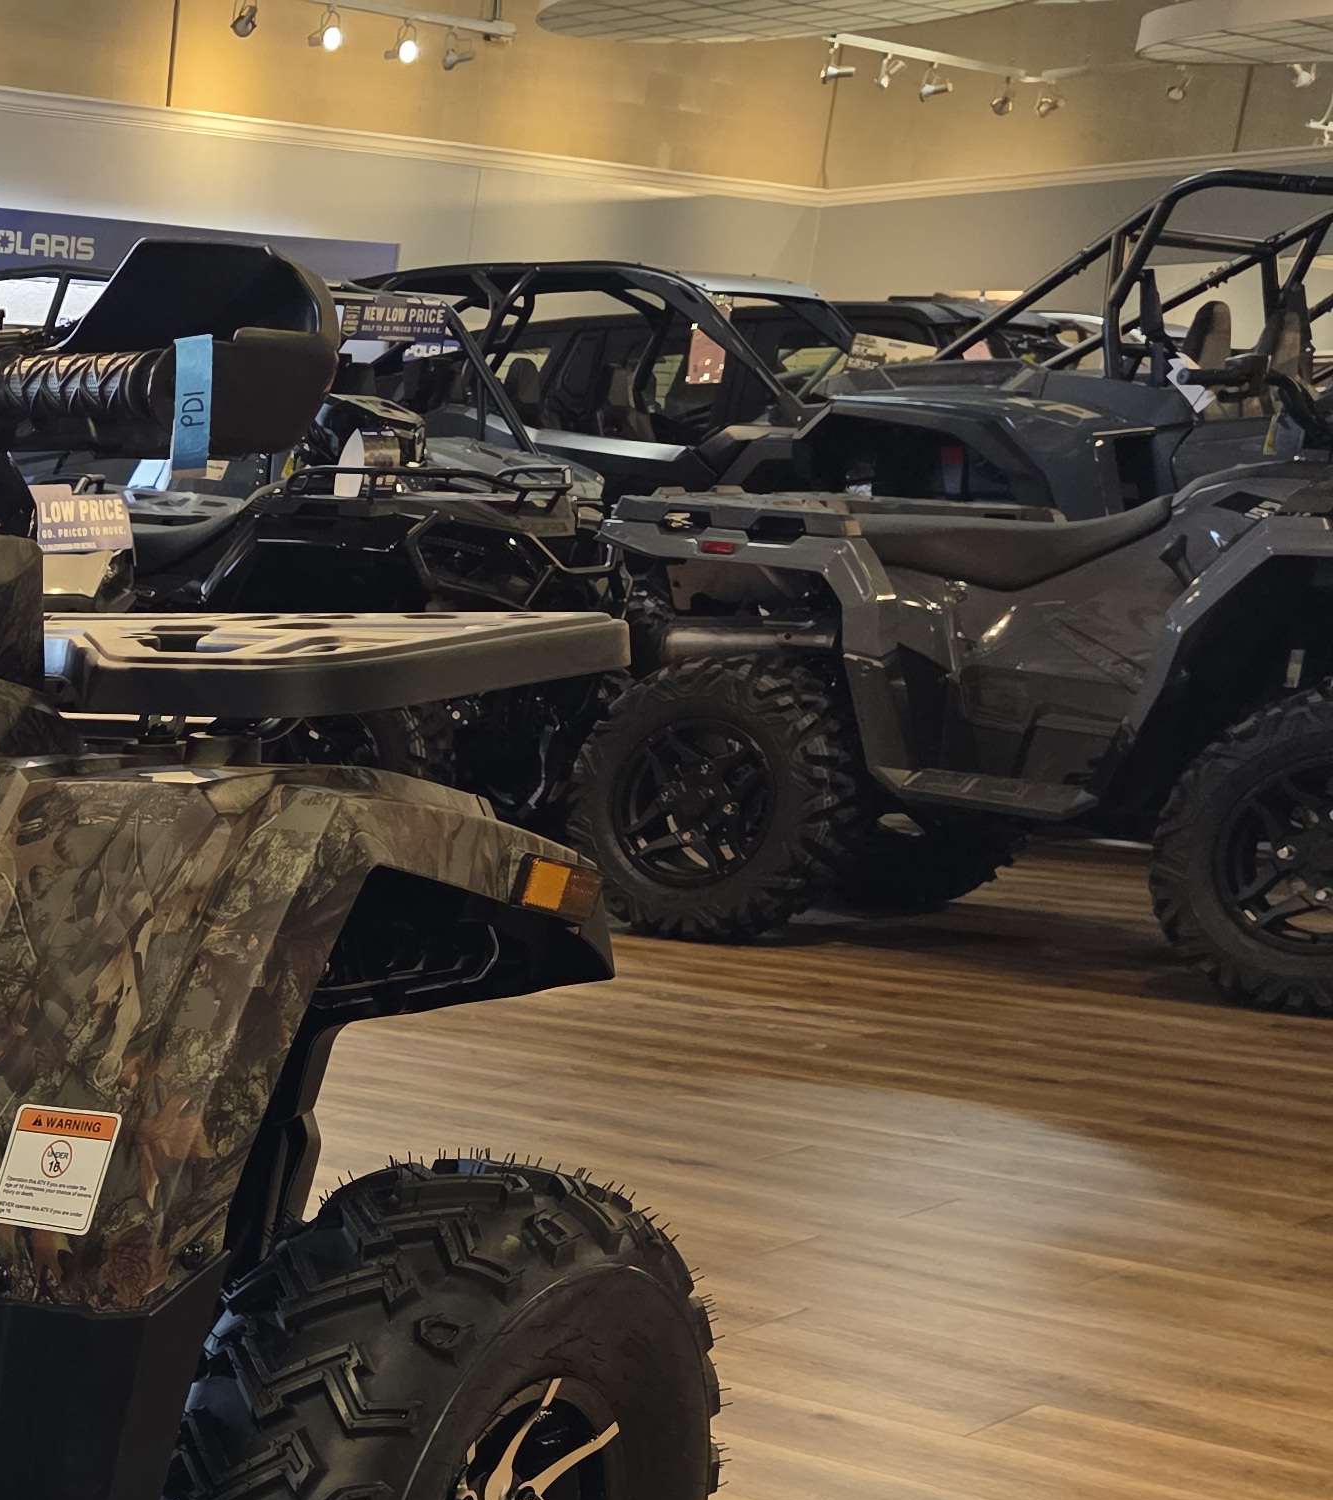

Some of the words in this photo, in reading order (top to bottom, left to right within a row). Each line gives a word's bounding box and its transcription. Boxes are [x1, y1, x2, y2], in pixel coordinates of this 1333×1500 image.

[364, 306, 385, 322] NEW
[385, 307, 407, 323] LOW
[409, 308, 446, 324] PRICE
[180, 391, 205, 428] PDI
[40, 501, 75, 524] LOW
[78, 498, 125, 522] PRICE
[57, 527, 88, 538] PRICED
[89, 526, 101, 536] TO
[102, 525, 127, 535] MOVE.
[46, 1116, 102, 1133] WARNING
[46, 1150, 69, 1160] UNDER
[48, 1160, 61, 1172] 16
